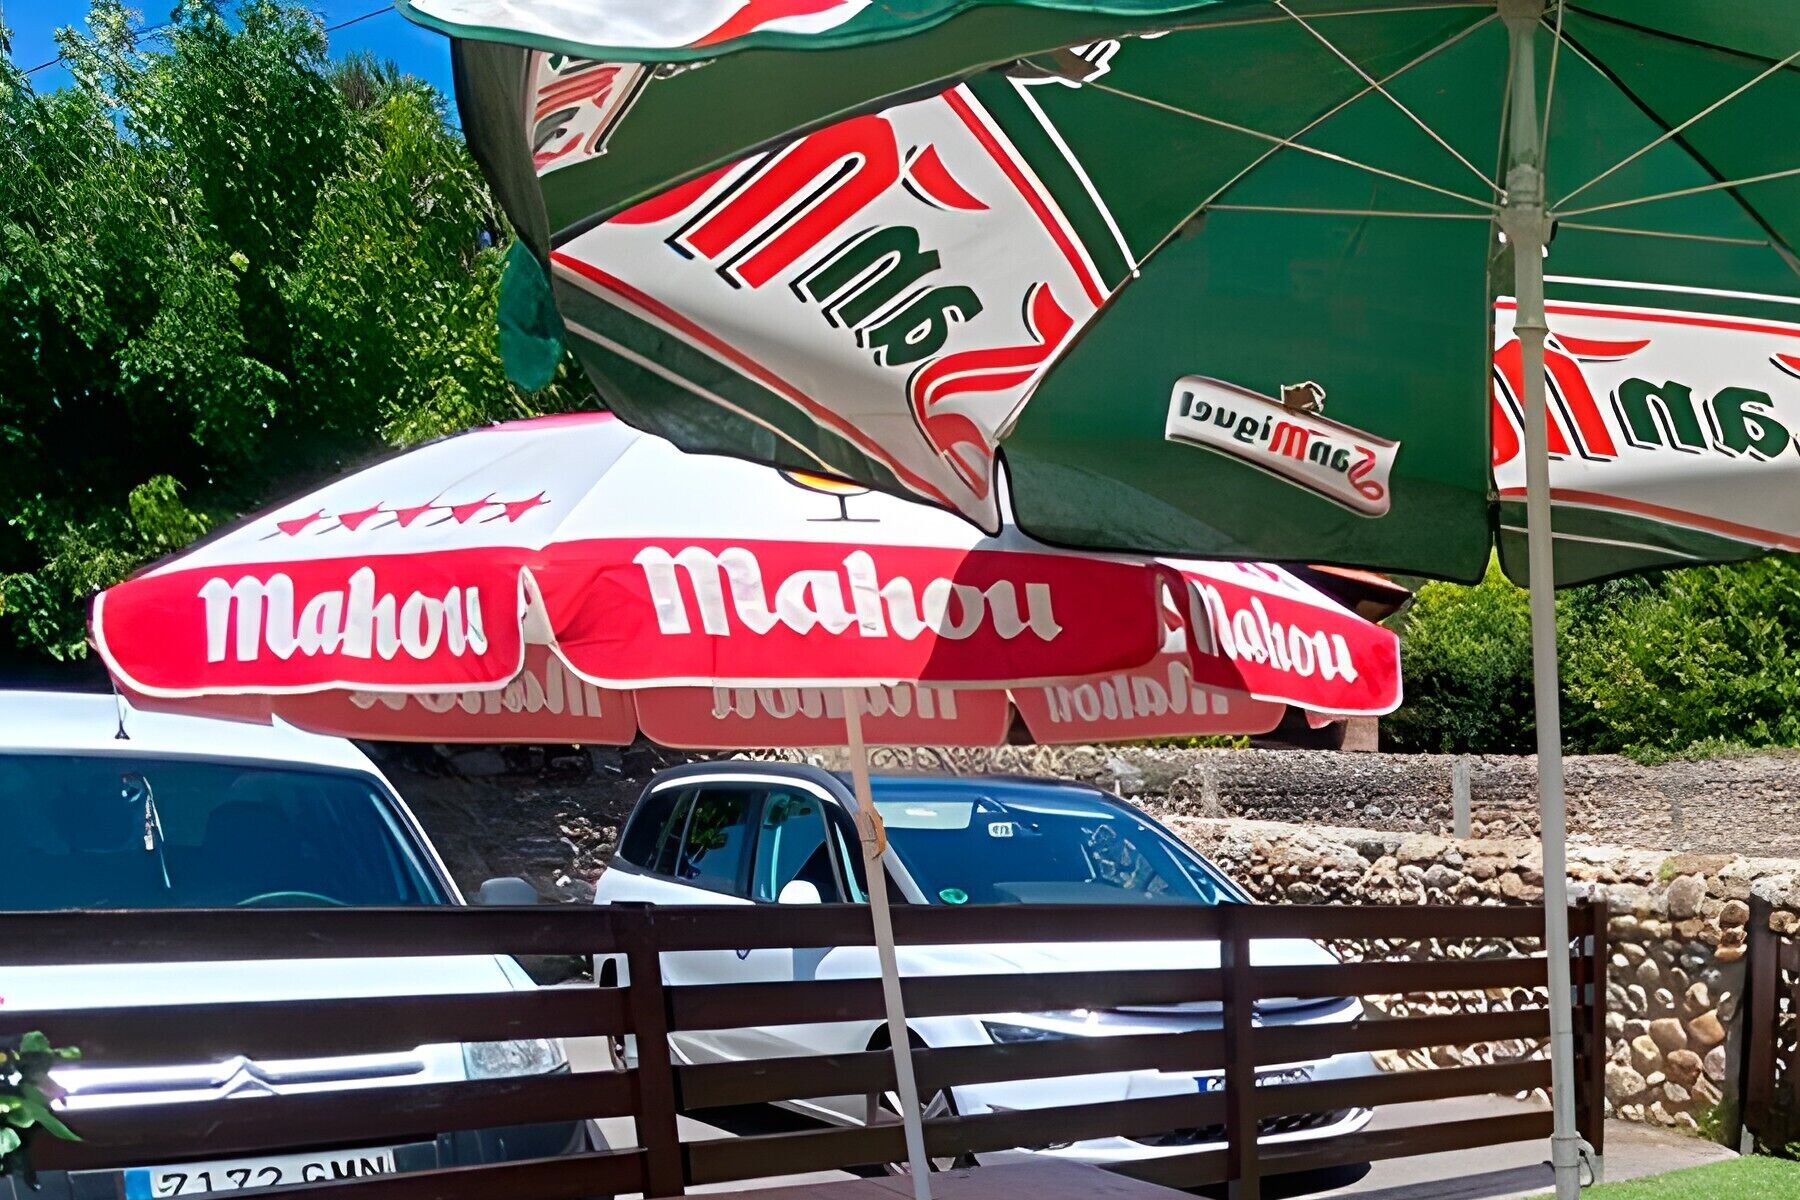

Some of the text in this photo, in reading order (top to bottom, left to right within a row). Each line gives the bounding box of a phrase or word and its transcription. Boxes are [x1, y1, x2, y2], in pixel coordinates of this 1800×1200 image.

[198, 565, 488, 663] Mahou
[632, 545, 1062, 641] Mahou
[1187, 578, 1359, 684] Mahou
